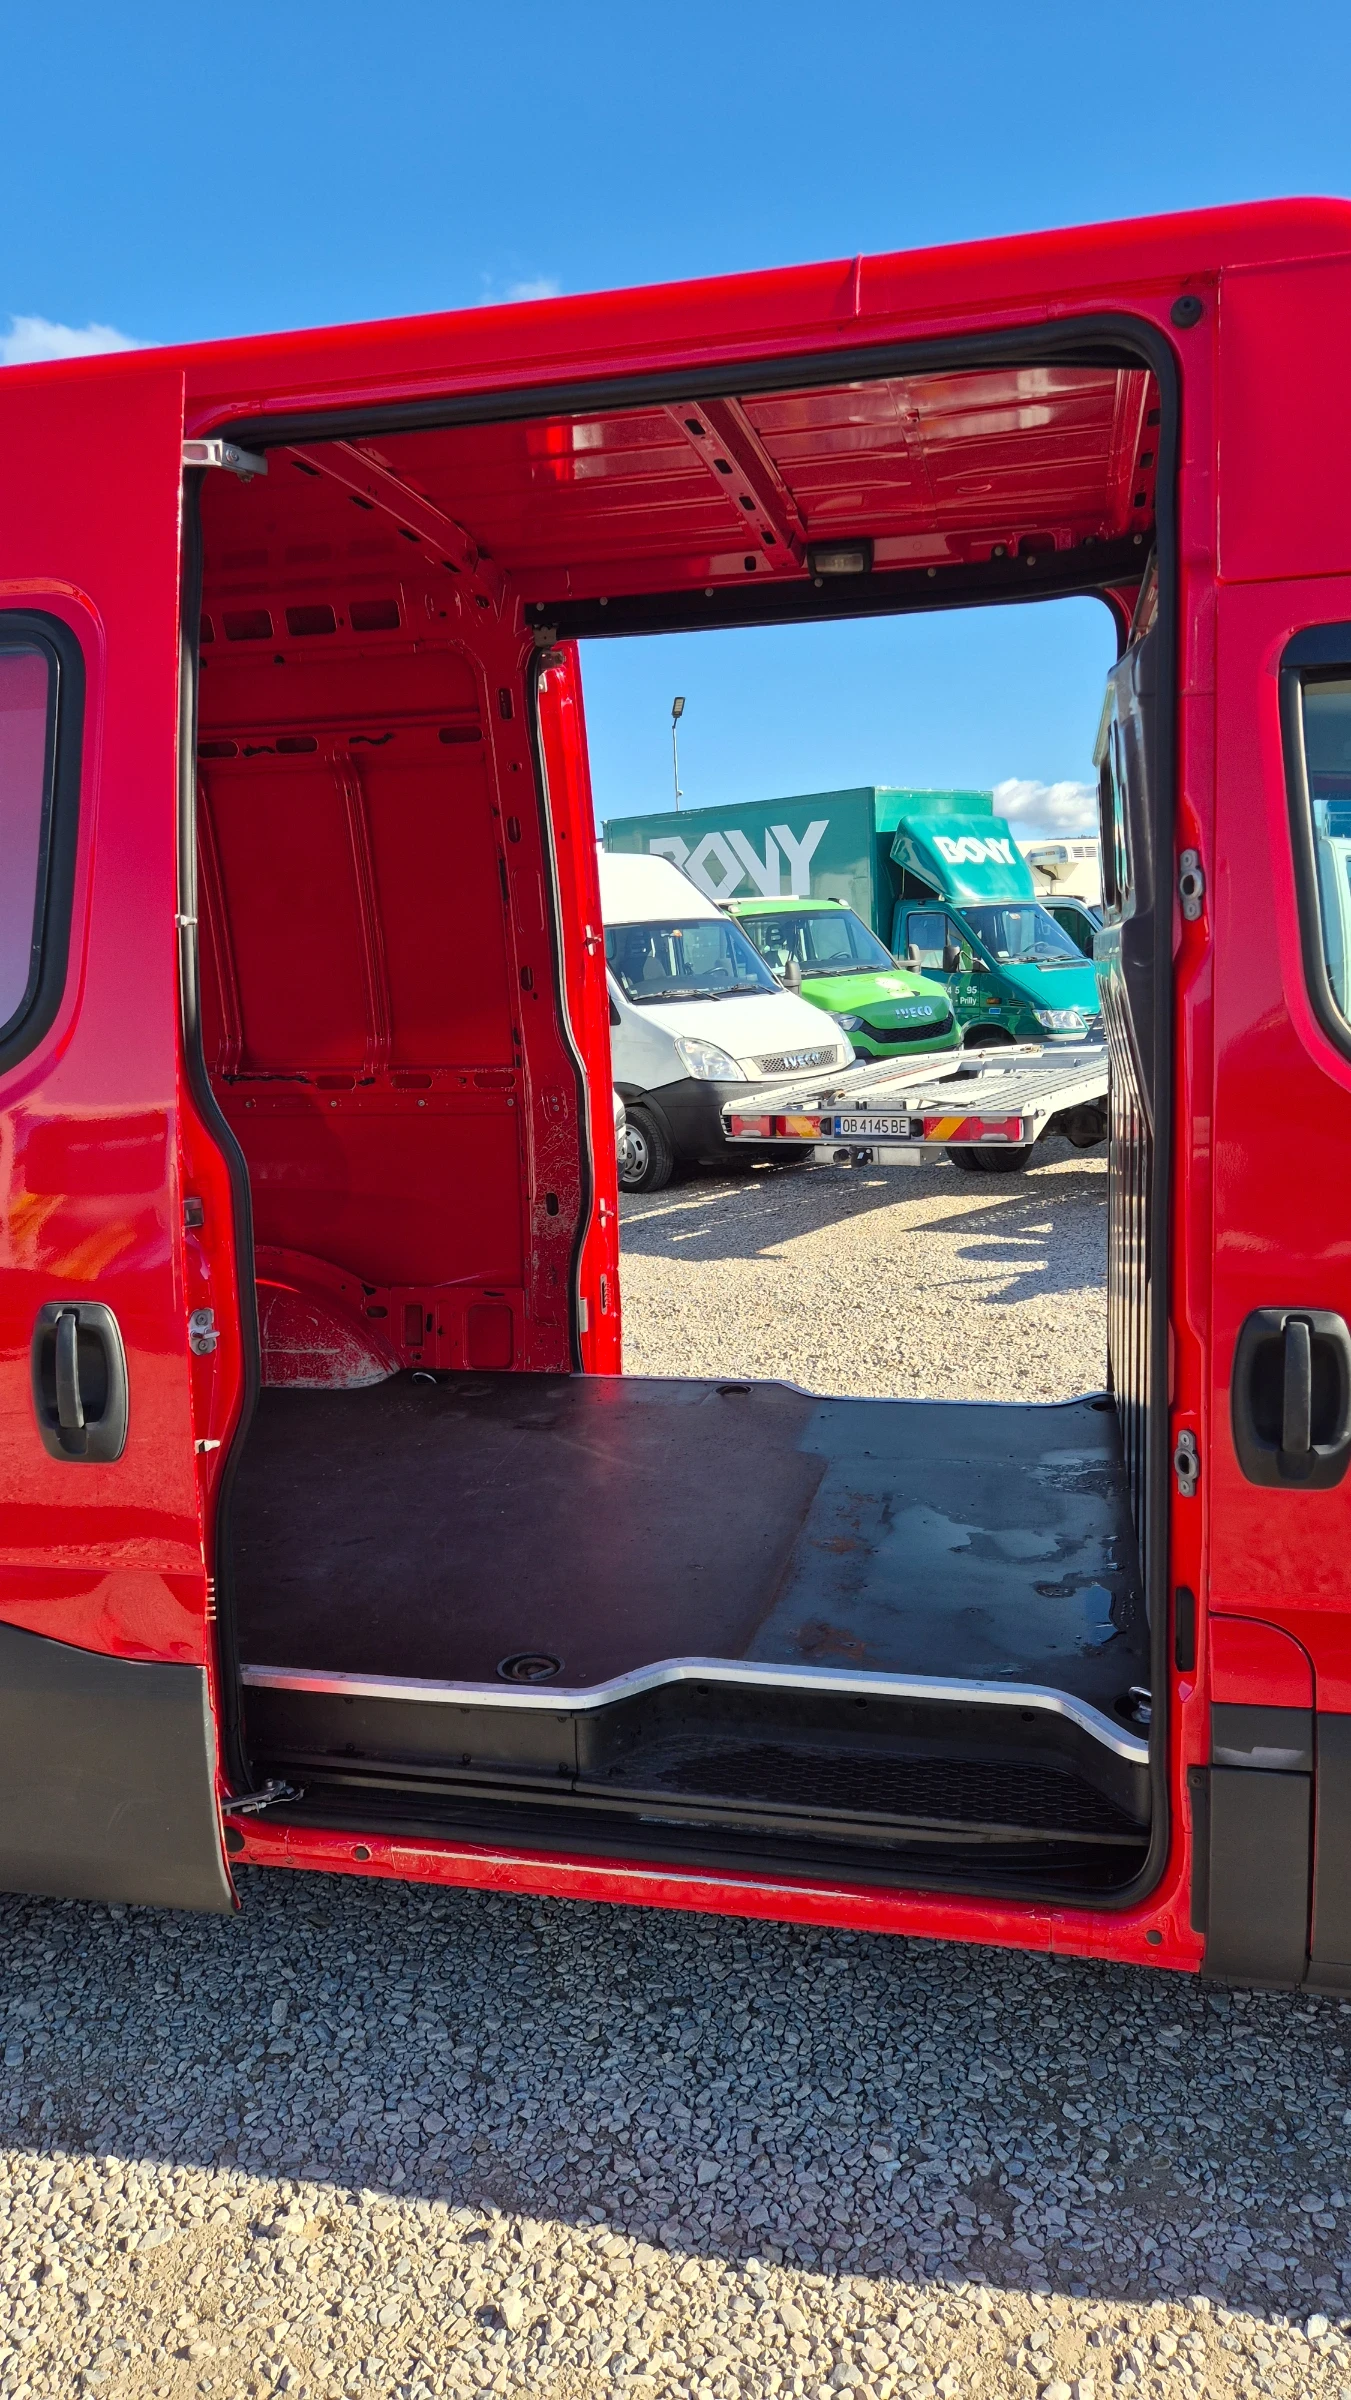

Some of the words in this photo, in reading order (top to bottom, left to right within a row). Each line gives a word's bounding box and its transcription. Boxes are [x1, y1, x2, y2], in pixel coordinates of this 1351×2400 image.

[967, 985, 978, 994] 95
[960, 997, 977, 1006] Prilly
[895, 1005, 932, 1019] IVECO
[783, 1053, 819, 1068] IVECO
[860, 1119, 889, 1134] 4145
[891, 1120, 907, 1134] BE
